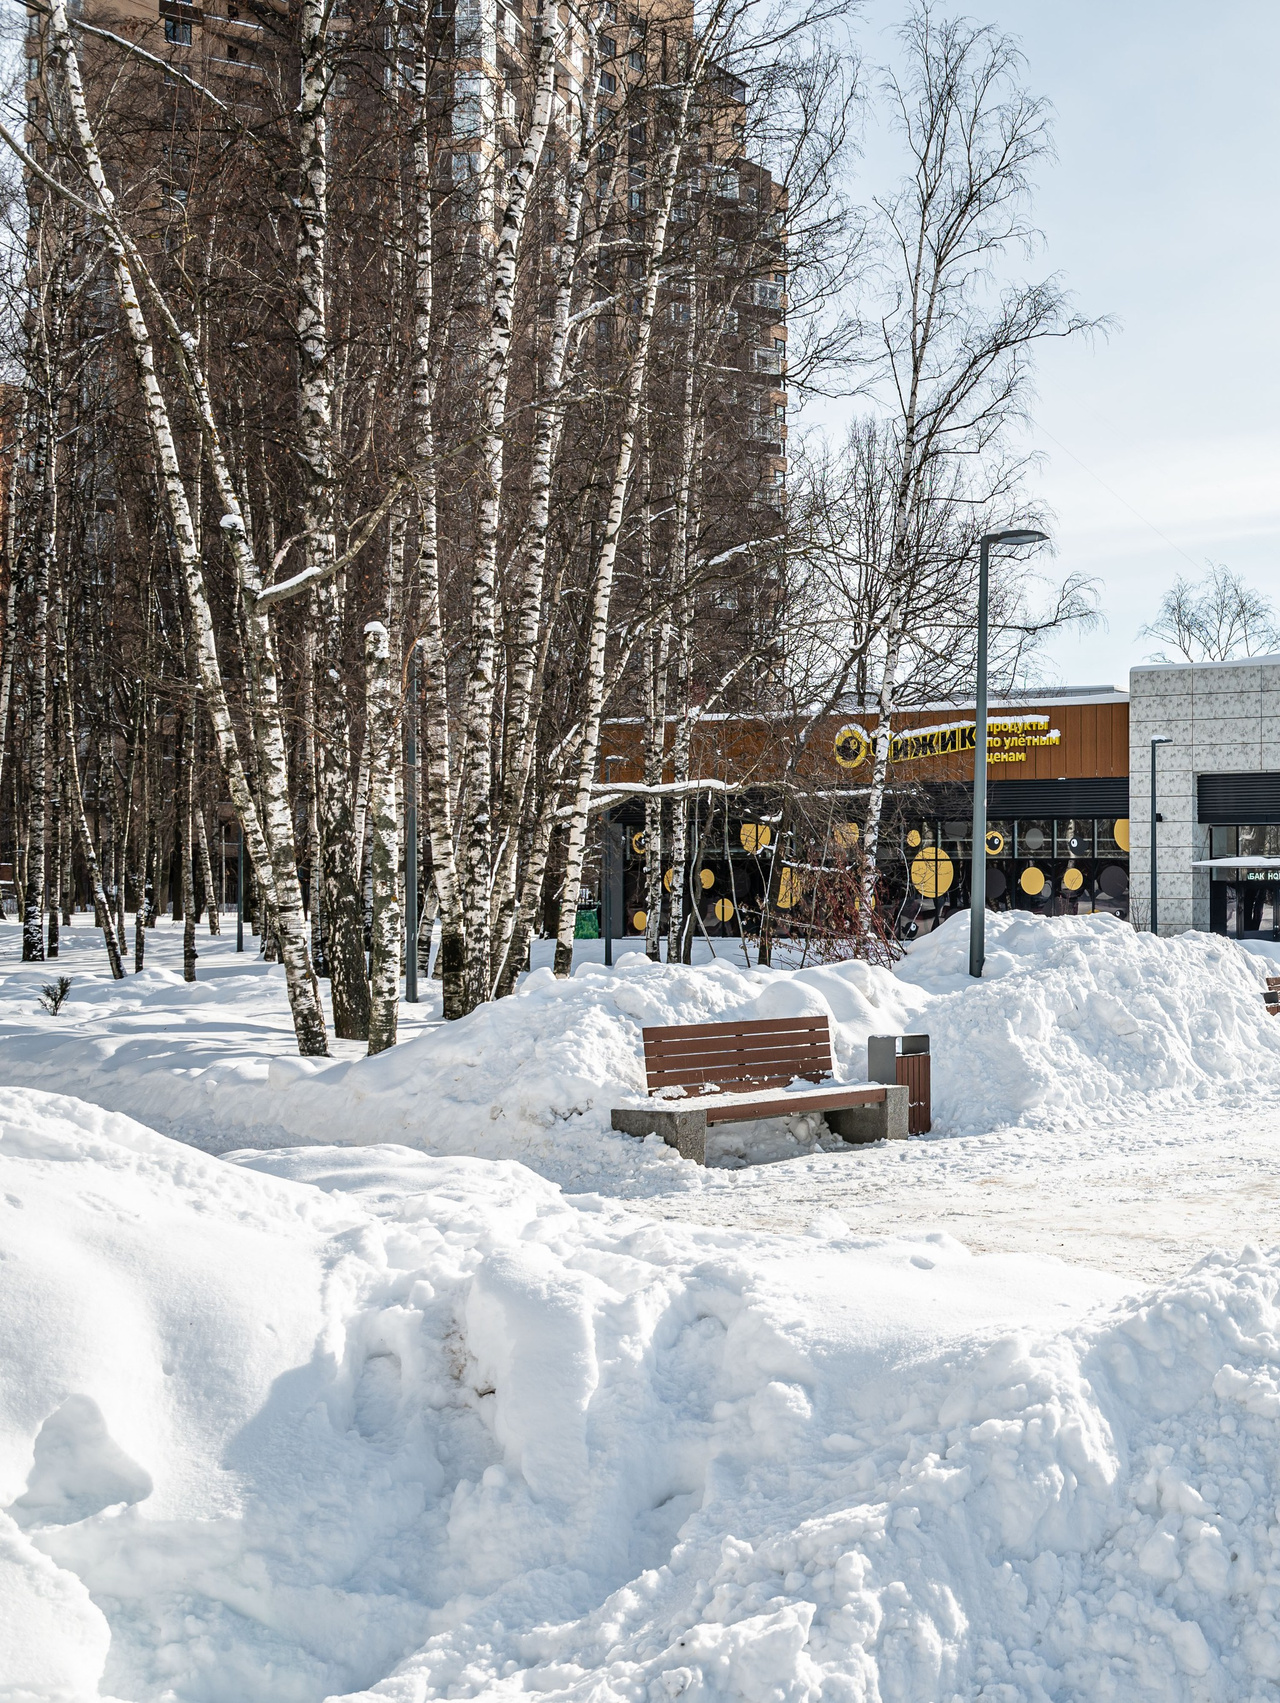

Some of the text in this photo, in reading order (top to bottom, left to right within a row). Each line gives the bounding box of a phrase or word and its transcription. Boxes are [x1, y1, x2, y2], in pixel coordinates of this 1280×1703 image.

[987, 722, 1049, 734] продукты
[987, 734, 1060, 750] по улётным
[986, 752, 1027, 764] ценам
[1247, 872, 1265, 880] БАК
